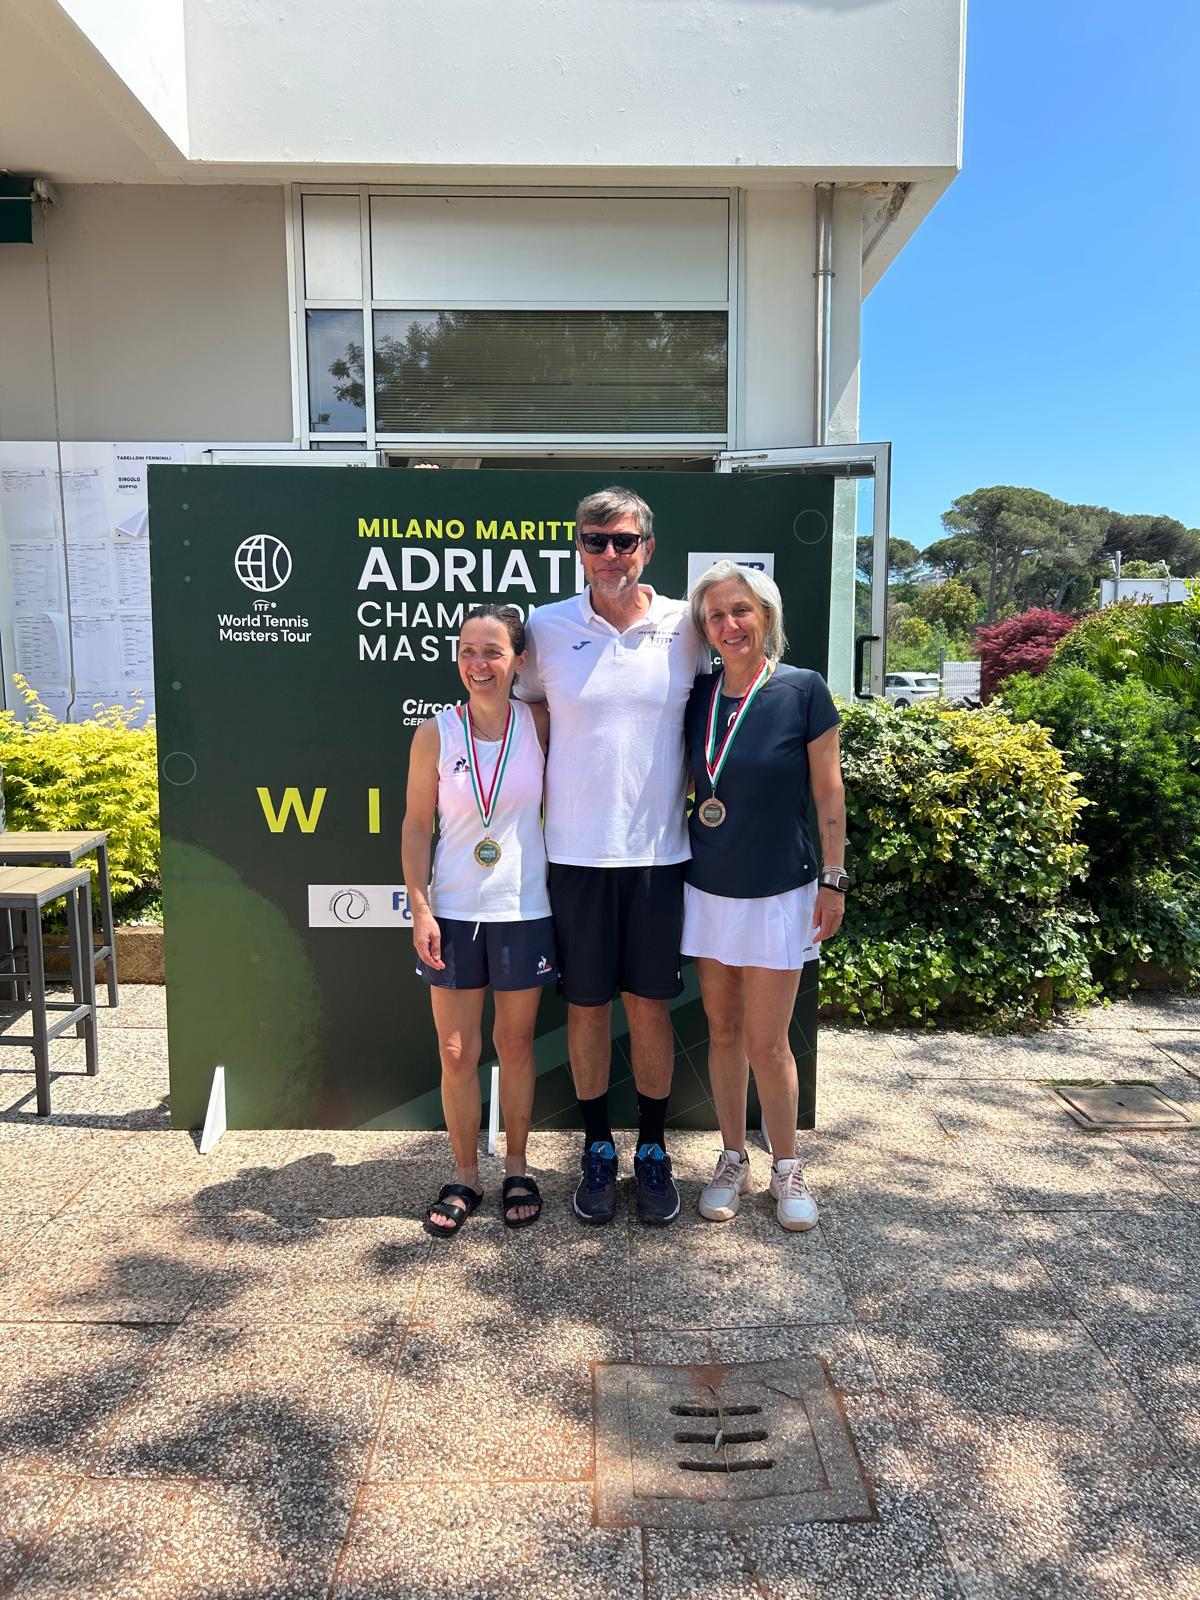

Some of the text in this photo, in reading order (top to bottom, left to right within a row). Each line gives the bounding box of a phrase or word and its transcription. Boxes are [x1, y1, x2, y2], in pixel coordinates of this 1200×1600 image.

[358, 518, 577, 541] MILANO MARITT
[357, 547, 584, 594] ADRIATI
[254, 604, 270, 612] ITF
[217, 614, 310, 628] World Tennis
[219, 628, 312, 643] Masters Tour
[358, 634, 461, 662] MAST
